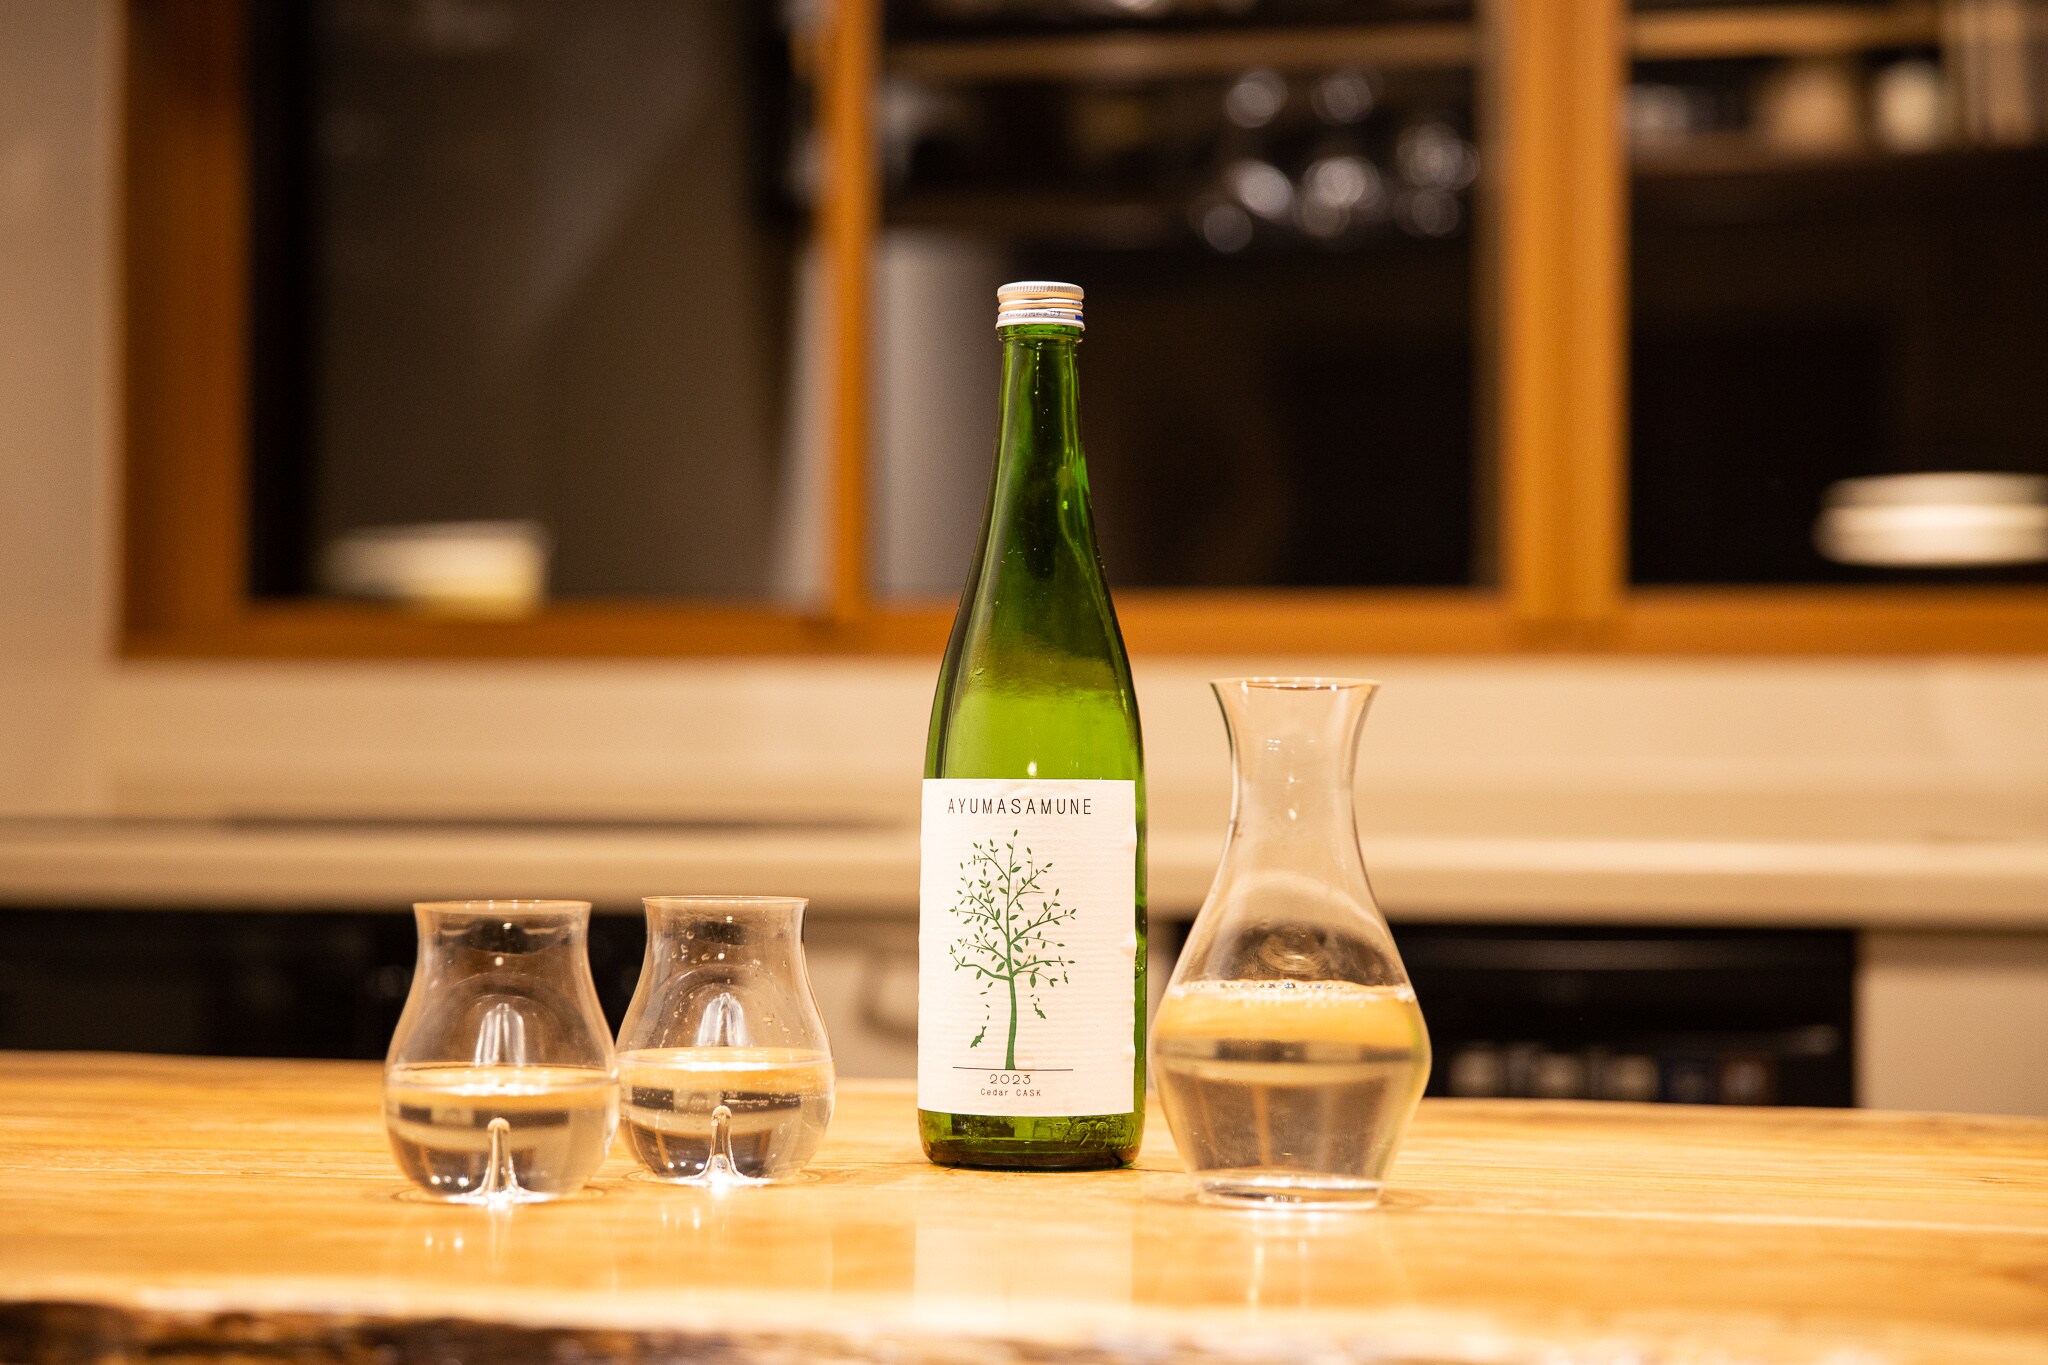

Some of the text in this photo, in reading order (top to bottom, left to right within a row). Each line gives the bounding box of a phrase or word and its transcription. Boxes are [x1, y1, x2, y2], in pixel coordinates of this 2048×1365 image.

[948, 798, 1092, 815] AYUMASAMUNE
[989, 1073, 1031, 1085] 2023
[980, 1088, 1042, 1097] Cedar CASK
